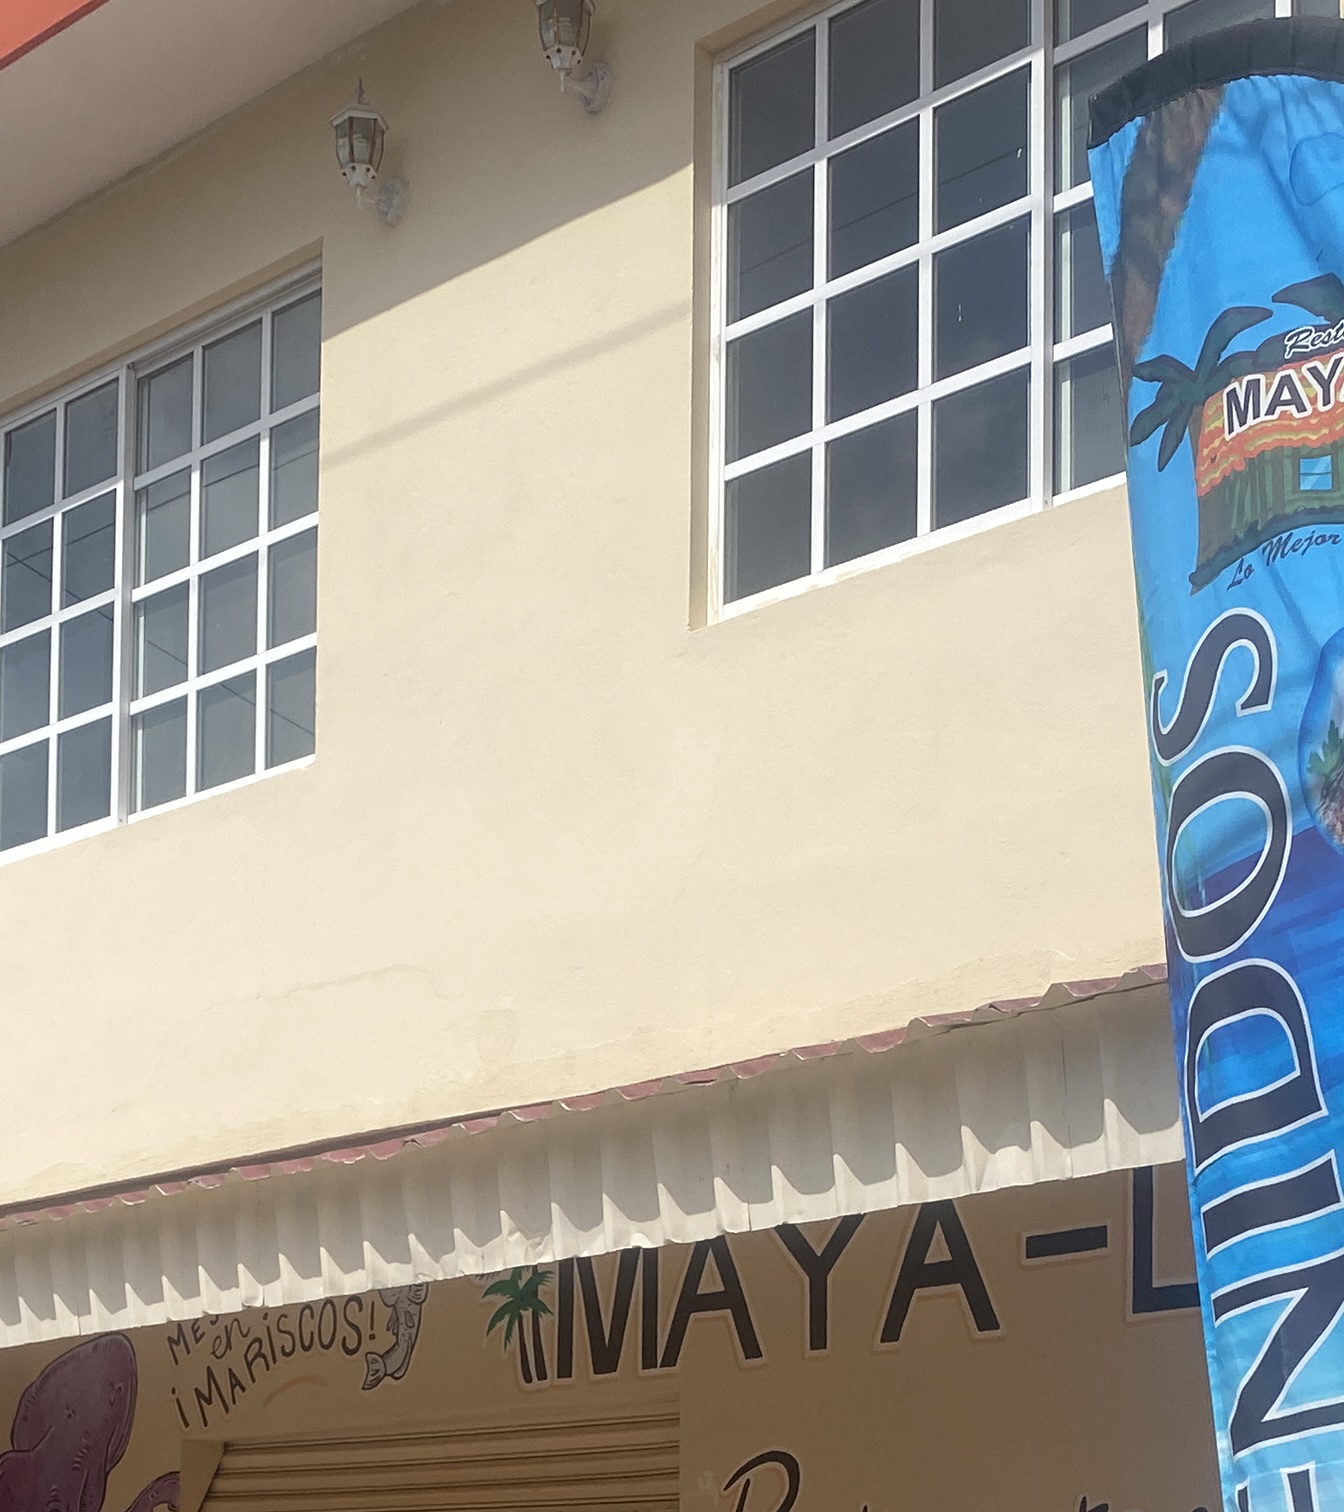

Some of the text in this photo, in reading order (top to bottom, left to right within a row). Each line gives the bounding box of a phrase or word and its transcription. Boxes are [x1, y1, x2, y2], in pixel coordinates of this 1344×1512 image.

[1227, 557, 1255, 591] Lo
[1262, 530, 1343, 567] Mejor
[211, 1318, 251, 1360] en
